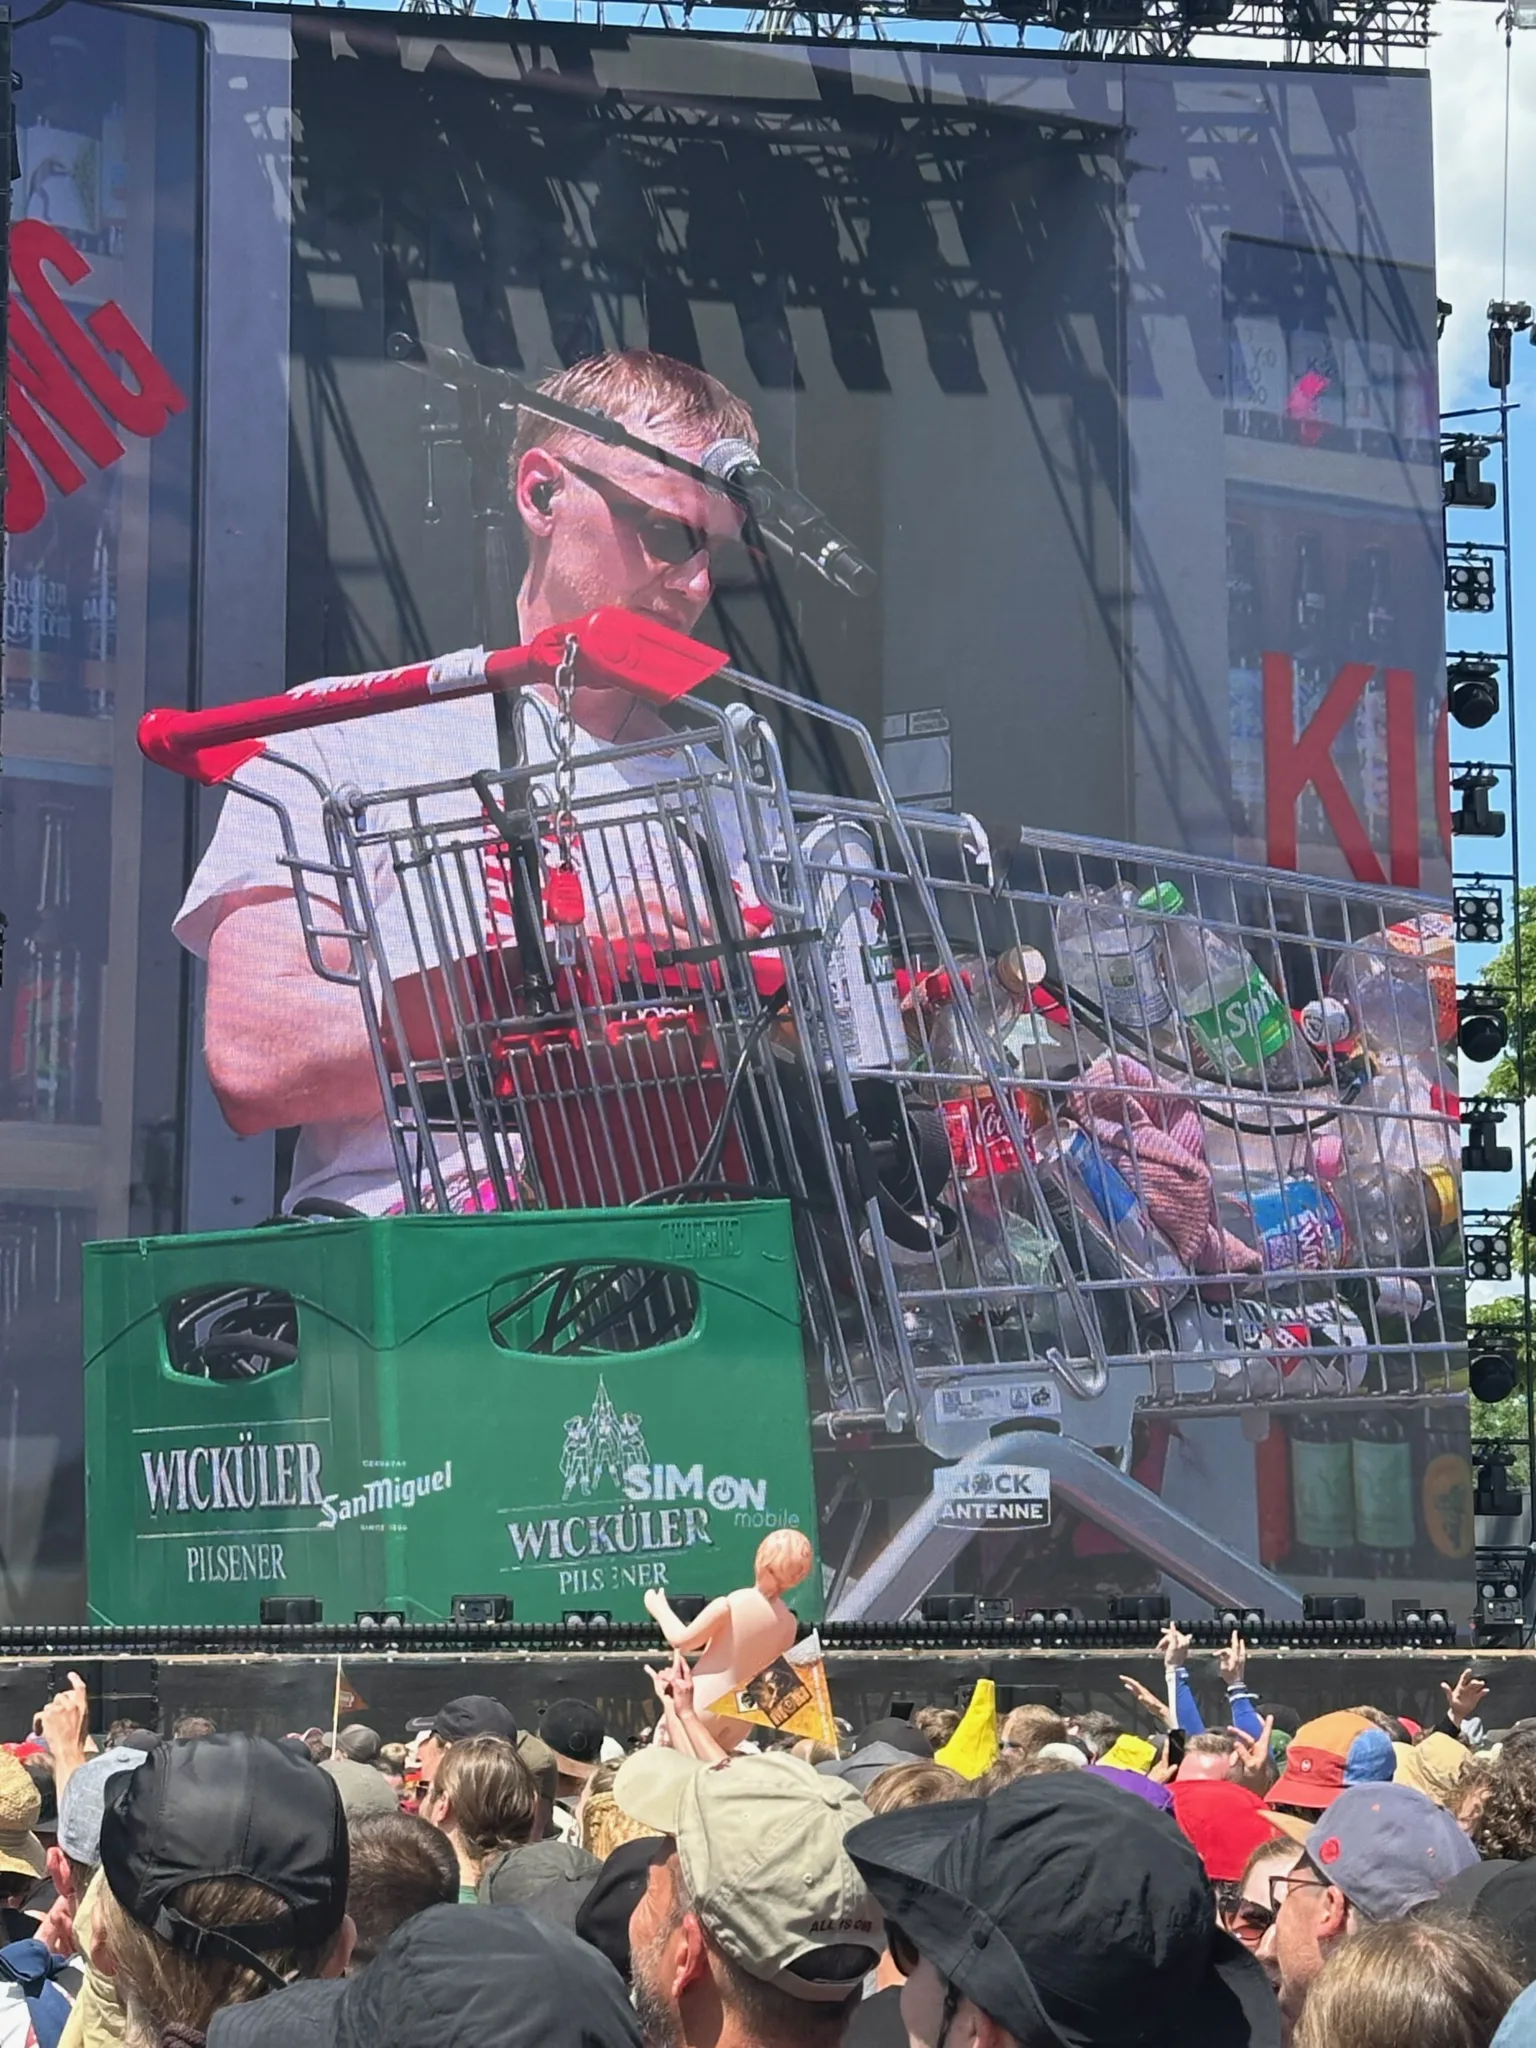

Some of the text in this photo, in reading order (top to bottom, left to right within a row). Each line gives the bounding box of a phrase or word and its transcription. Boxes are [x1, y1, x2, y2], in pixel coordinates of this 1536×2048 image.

[6, 218, 190, 534] NG
[1263, 651, 1452, 888] KI
[140, 1431, 324, 1515] WICKÜLER
[507, 1504, 714, 1561] WICKÜLER
[734, 1509, 800, 1529] mobile
[942, 1503, 1043, 1520] ANTENNE
[187, 1544, 287, 1582] PILSENER
